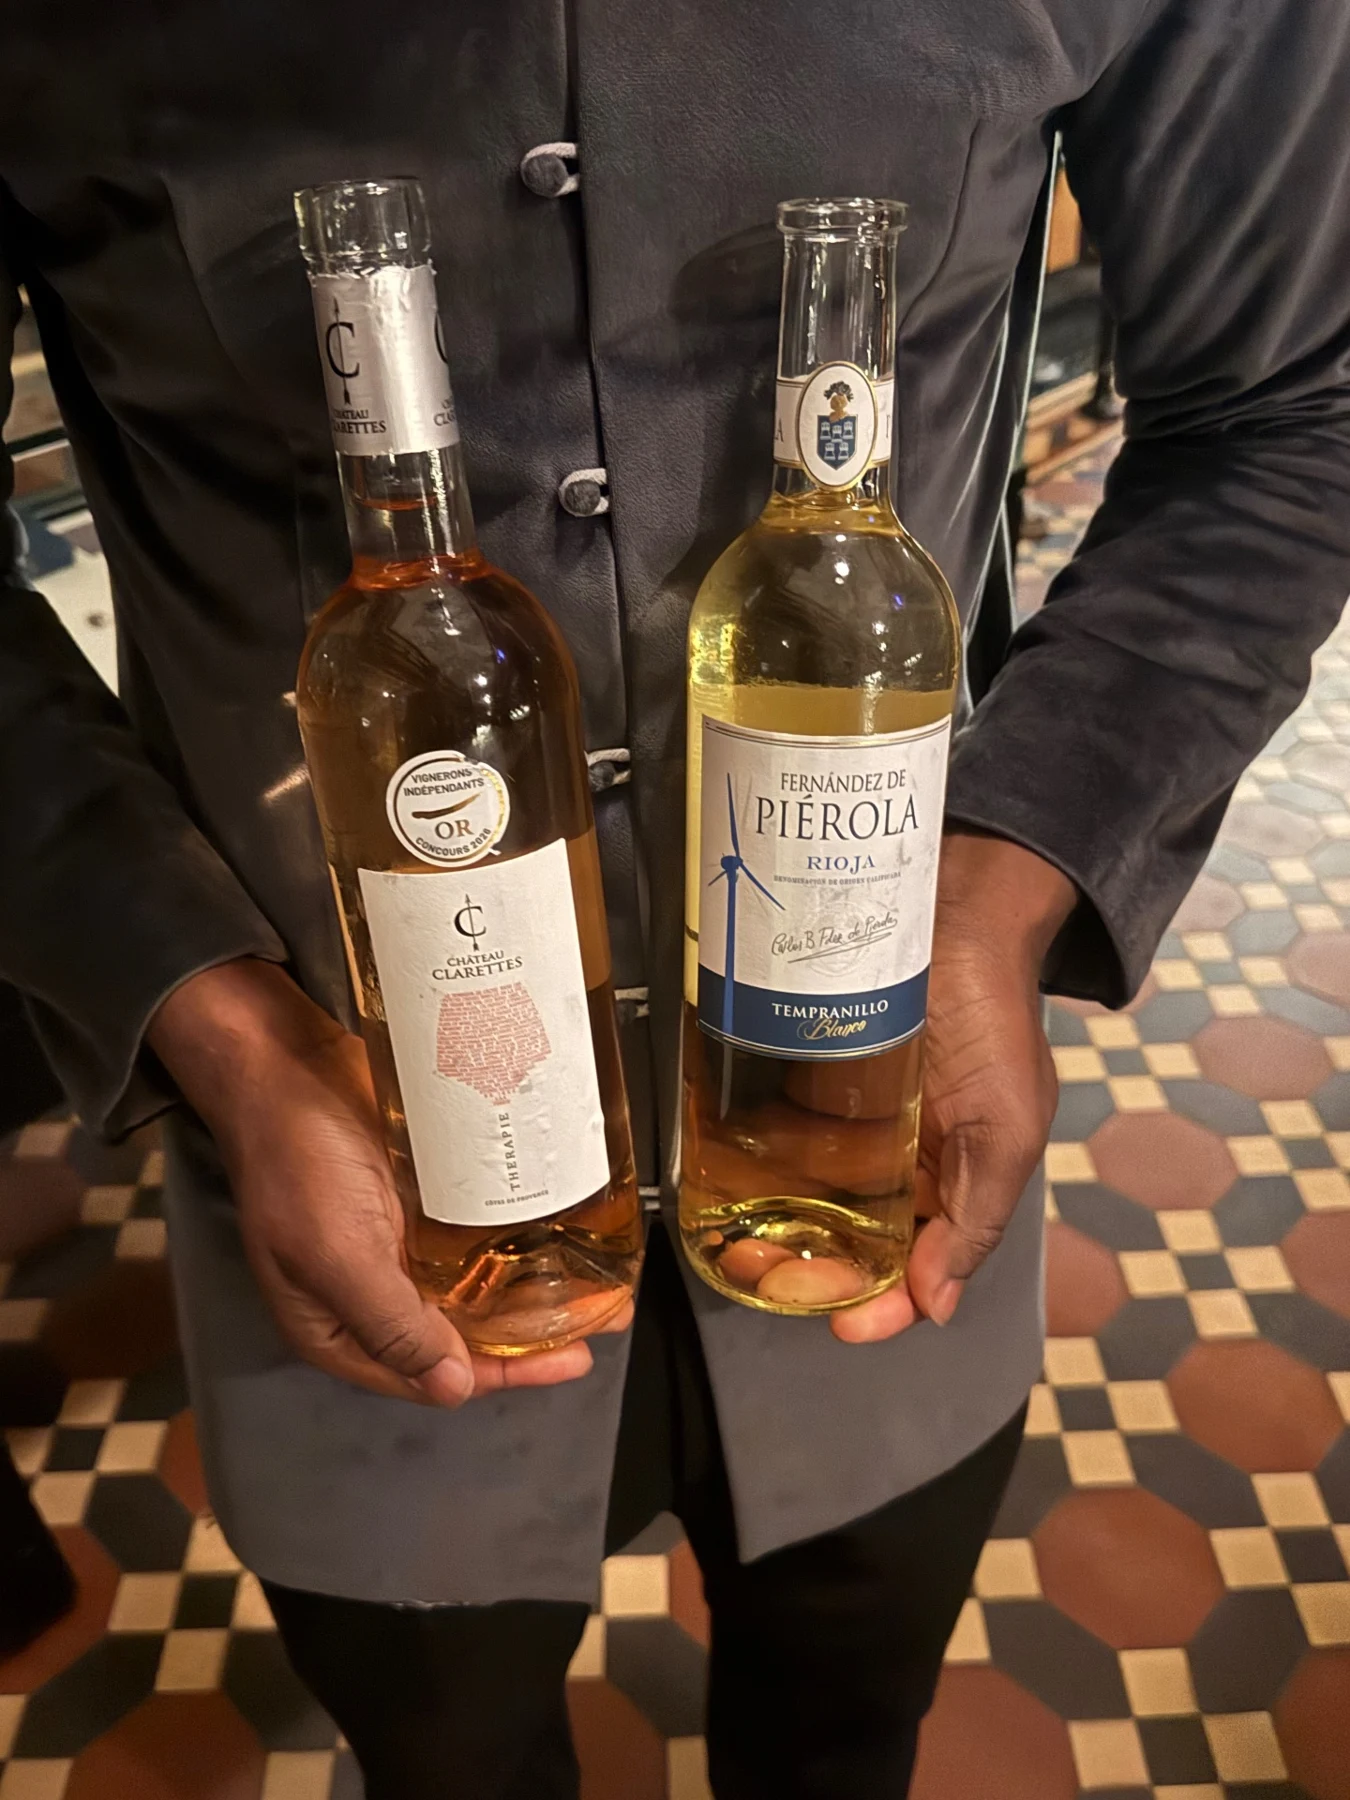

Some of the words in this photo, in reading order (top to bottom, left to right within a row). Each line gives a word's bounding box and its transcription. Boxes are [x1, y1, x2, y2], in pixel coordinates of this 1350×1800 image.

[333, 420, 387, 434] ARETTES
[403, 777, 485, 796] INDÉPENDANTS
[411, 768, 473, 784] VIGNERONS
[780, 771, 883, 794] FERNÁNDEZ
[887, 768, 906, 789] DE
[755, 794, 919, 841] PIÉROLA
[434, 819, 475, 840] OR
[415, 836, 471, 856] CONCOURS
[807, 853, 876, 875] RIOJA
[828, 878, 838, 886] DE
[838, 877, 865, 886] ORIGEN
[771, 932, 803, 956] Carlos
[432, 956, 523, 981] CLARETTES
[771, 999, 889, 1019] TEMPRANILLO
[796, 1018, 867, 1040] Blanco
[498, 1112, 521, 1192] THERAPIE
